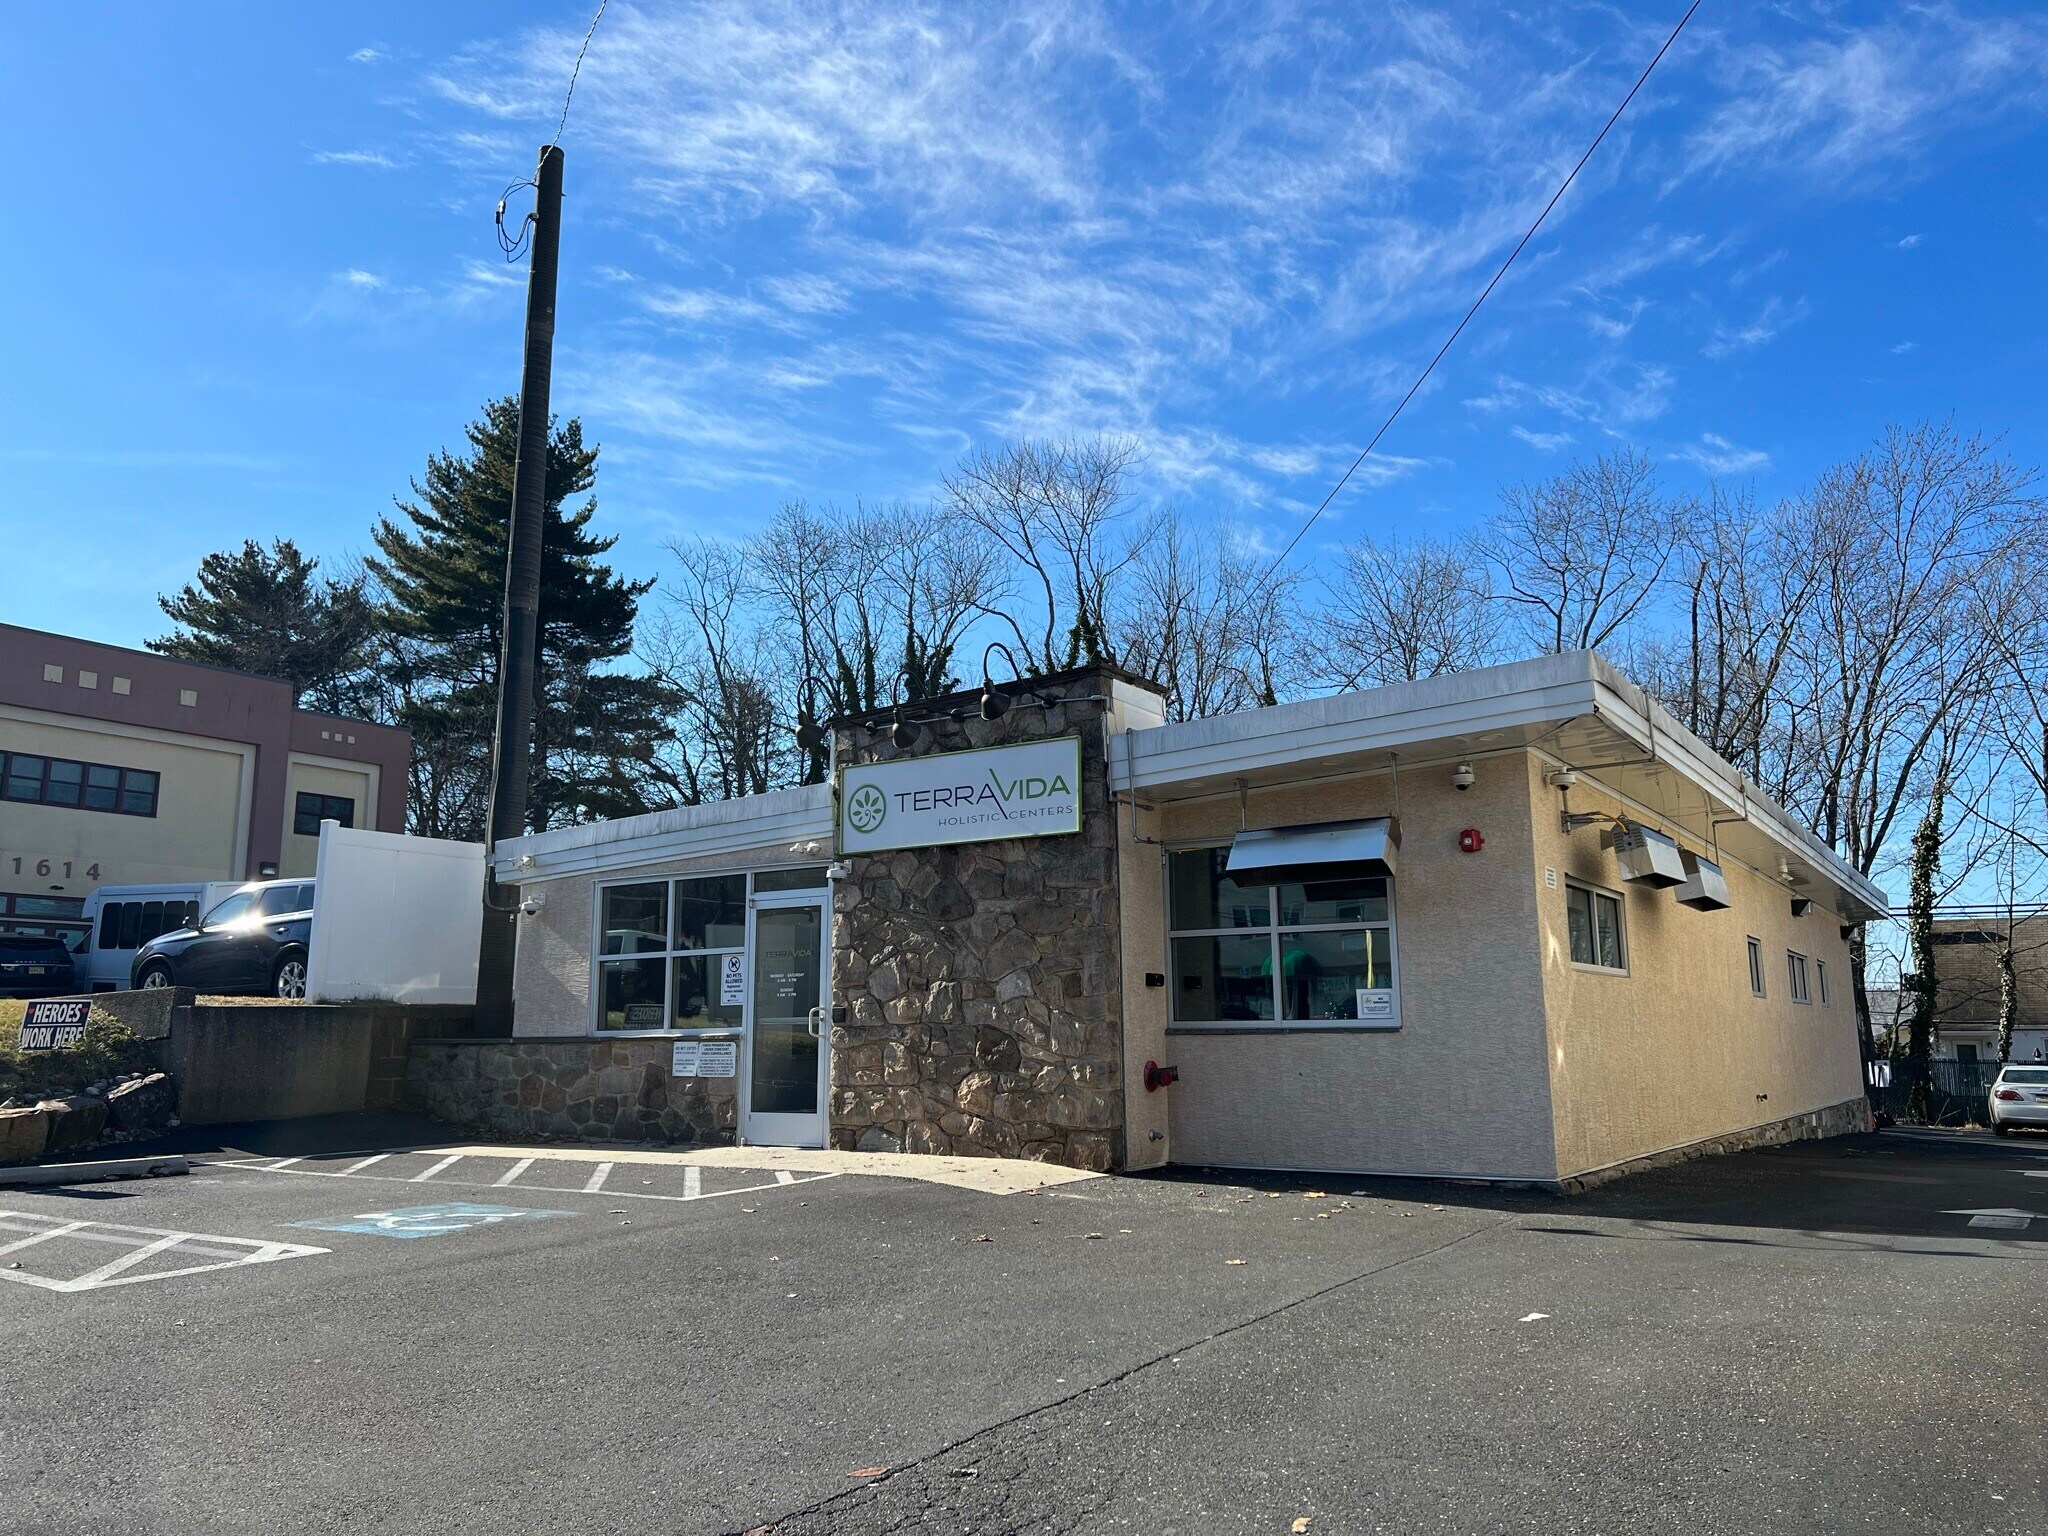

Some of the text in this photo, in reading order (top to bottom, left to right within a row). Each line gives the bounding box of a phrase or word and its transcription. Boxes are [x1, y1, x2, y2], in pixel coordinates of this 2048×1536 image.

[938, 805, 1073, 827] HOLISTIC CENTERS
[12, 857, 100, 881] 1614
[32, 1003, 83, 1023] HEROES
[21, 1027, 54, 1048] WORK
